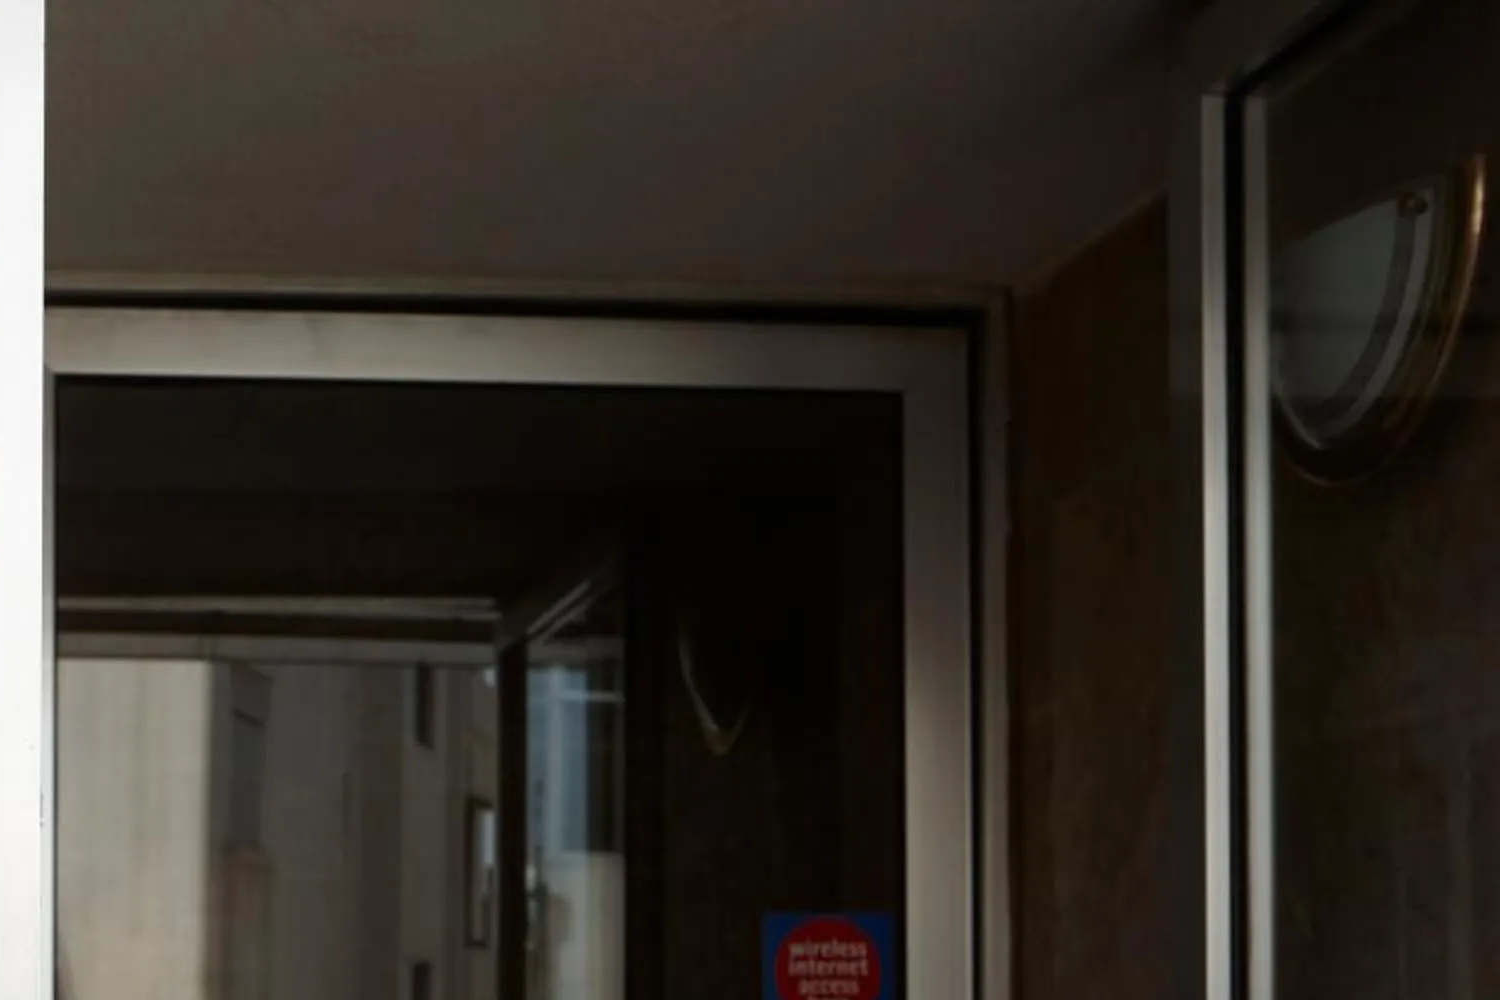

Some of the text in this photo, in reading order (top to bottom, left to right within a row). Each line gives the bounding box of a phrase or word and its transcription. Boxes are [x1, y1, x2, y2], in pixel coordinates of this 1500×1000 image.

[789, 938, 868, 957] wireless
[788, 958, 869, 977] internet
[798, 979, 860, 995] access
